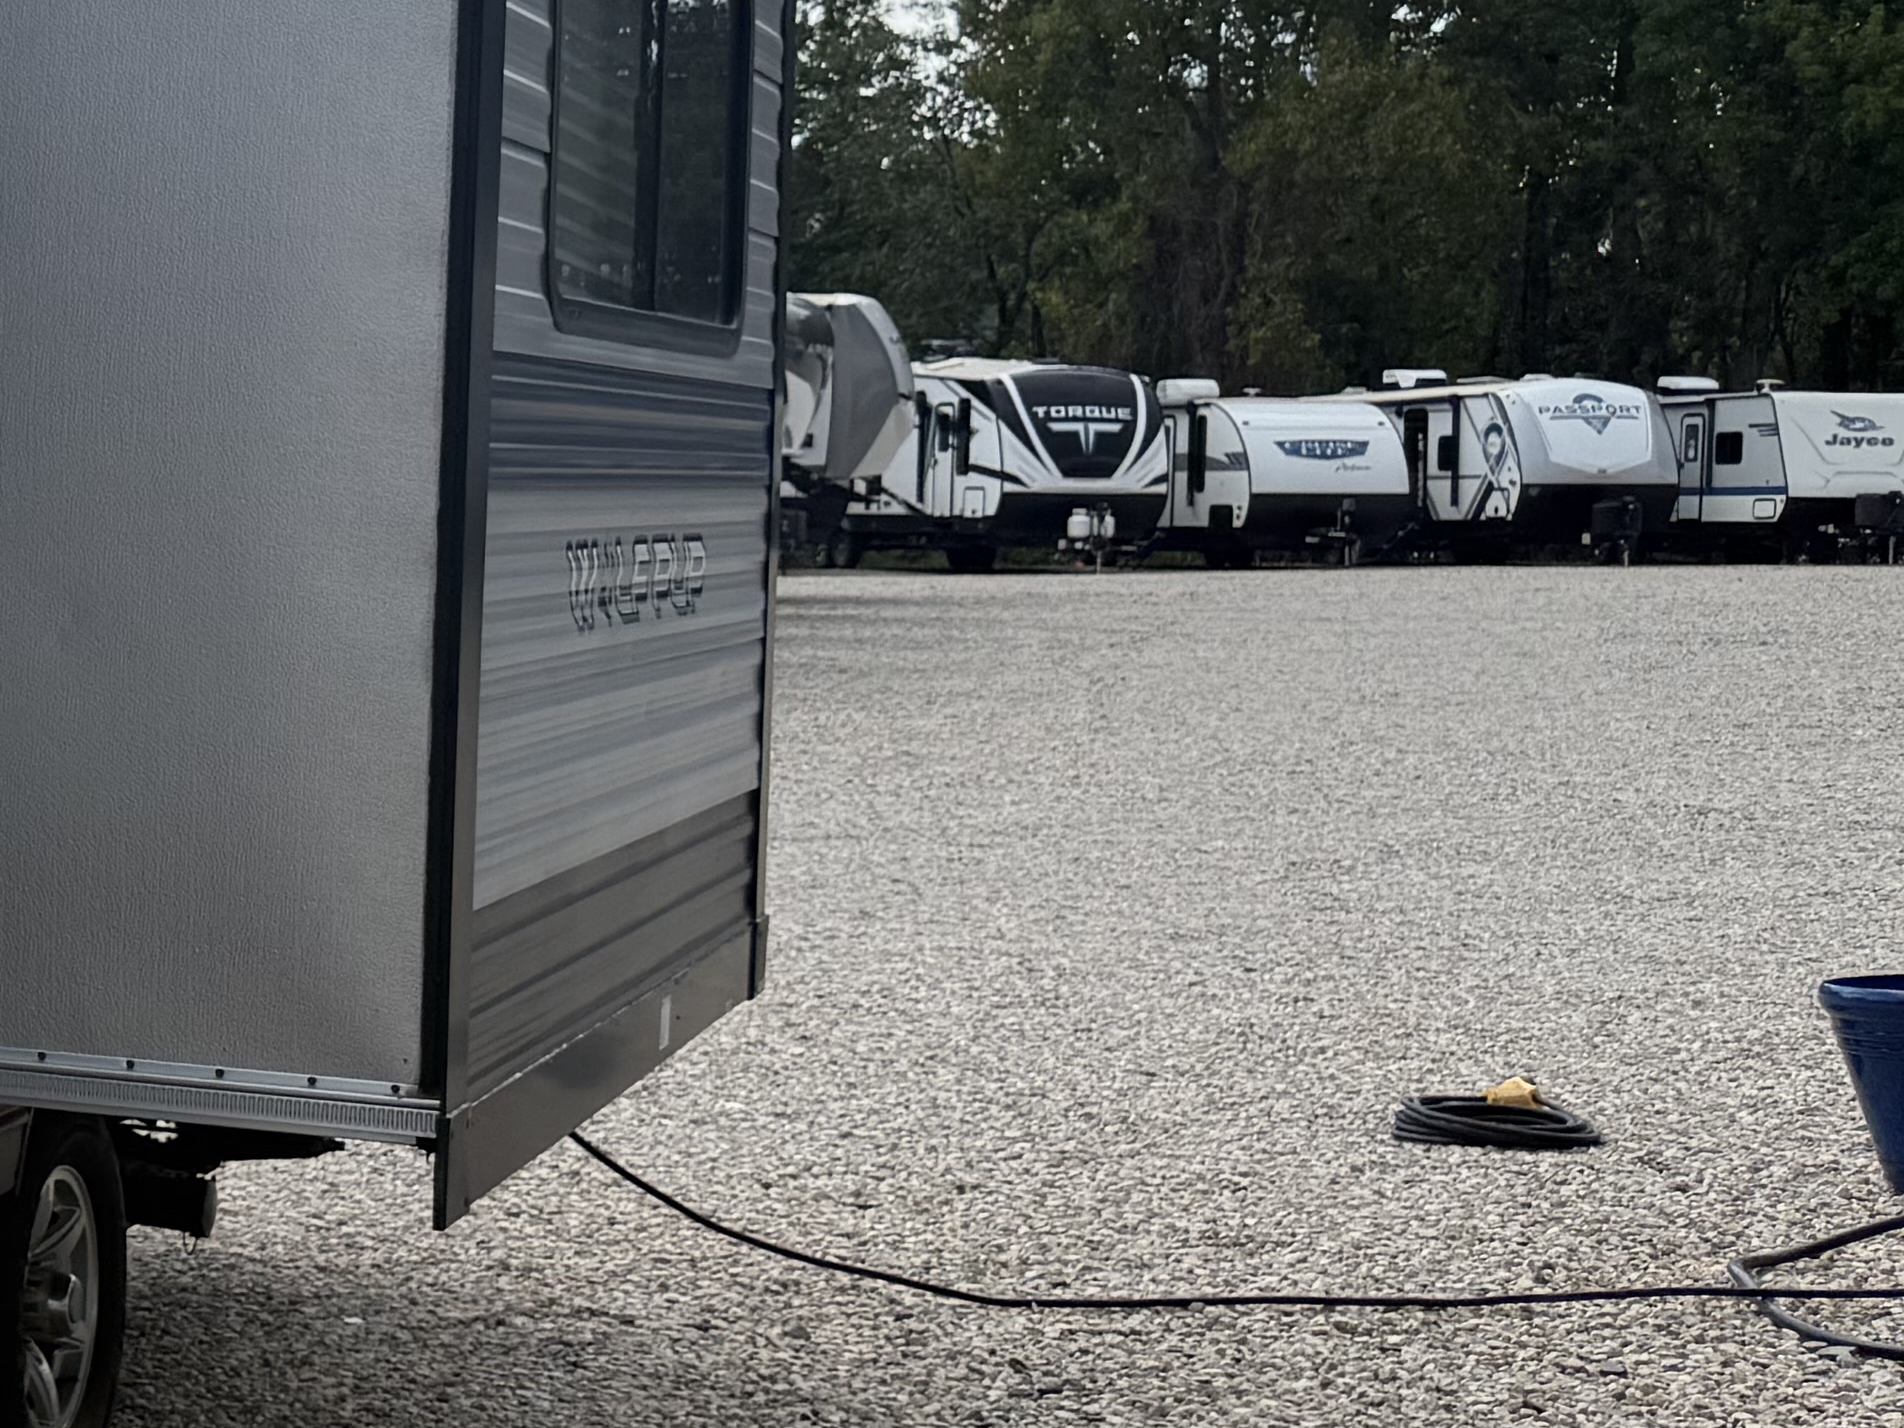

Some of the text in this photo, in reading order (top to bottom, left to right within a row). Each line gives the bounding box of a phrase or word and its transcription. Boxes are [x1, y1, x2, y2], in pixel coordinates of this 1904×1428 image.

[1032, 405, 1133, 421] TORQUE
[1538, 404, 1641, 418] PASSPORT
[1824, 433, 1895, 449] Jayco
